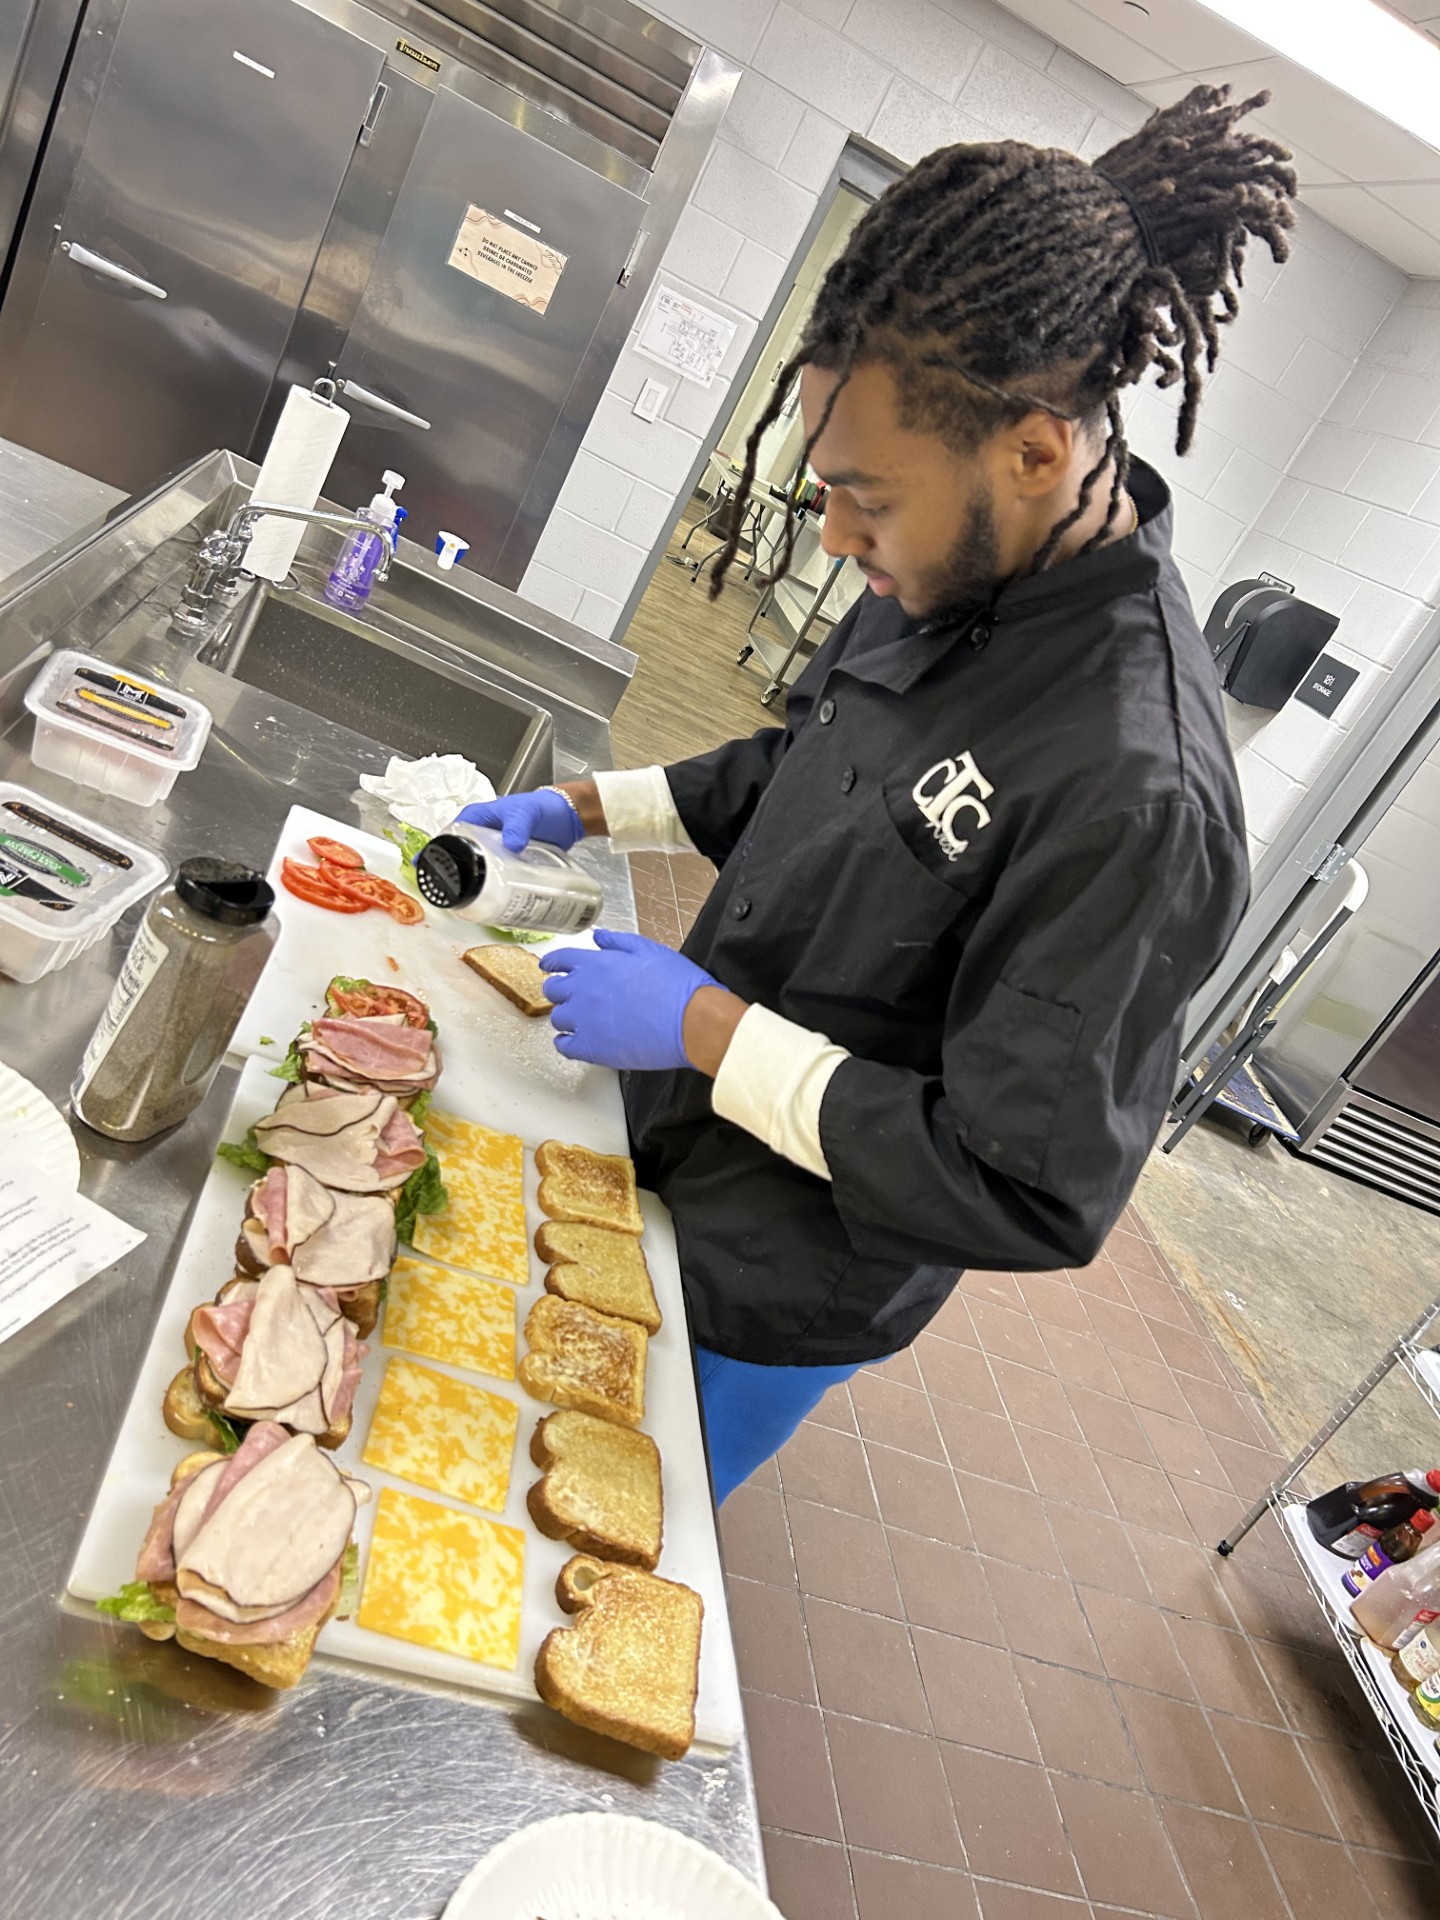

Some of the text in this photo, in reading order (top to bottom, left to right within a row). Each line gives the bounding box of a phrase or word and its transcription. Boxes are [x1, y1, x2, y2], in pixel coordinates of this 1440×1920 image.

[483, 245, 498, 257] DRINKS
[498, 246, 512, 257] PLACE
[515, 271, 533, 283] FREEZER
[912, 750, 995, 853] CTC
